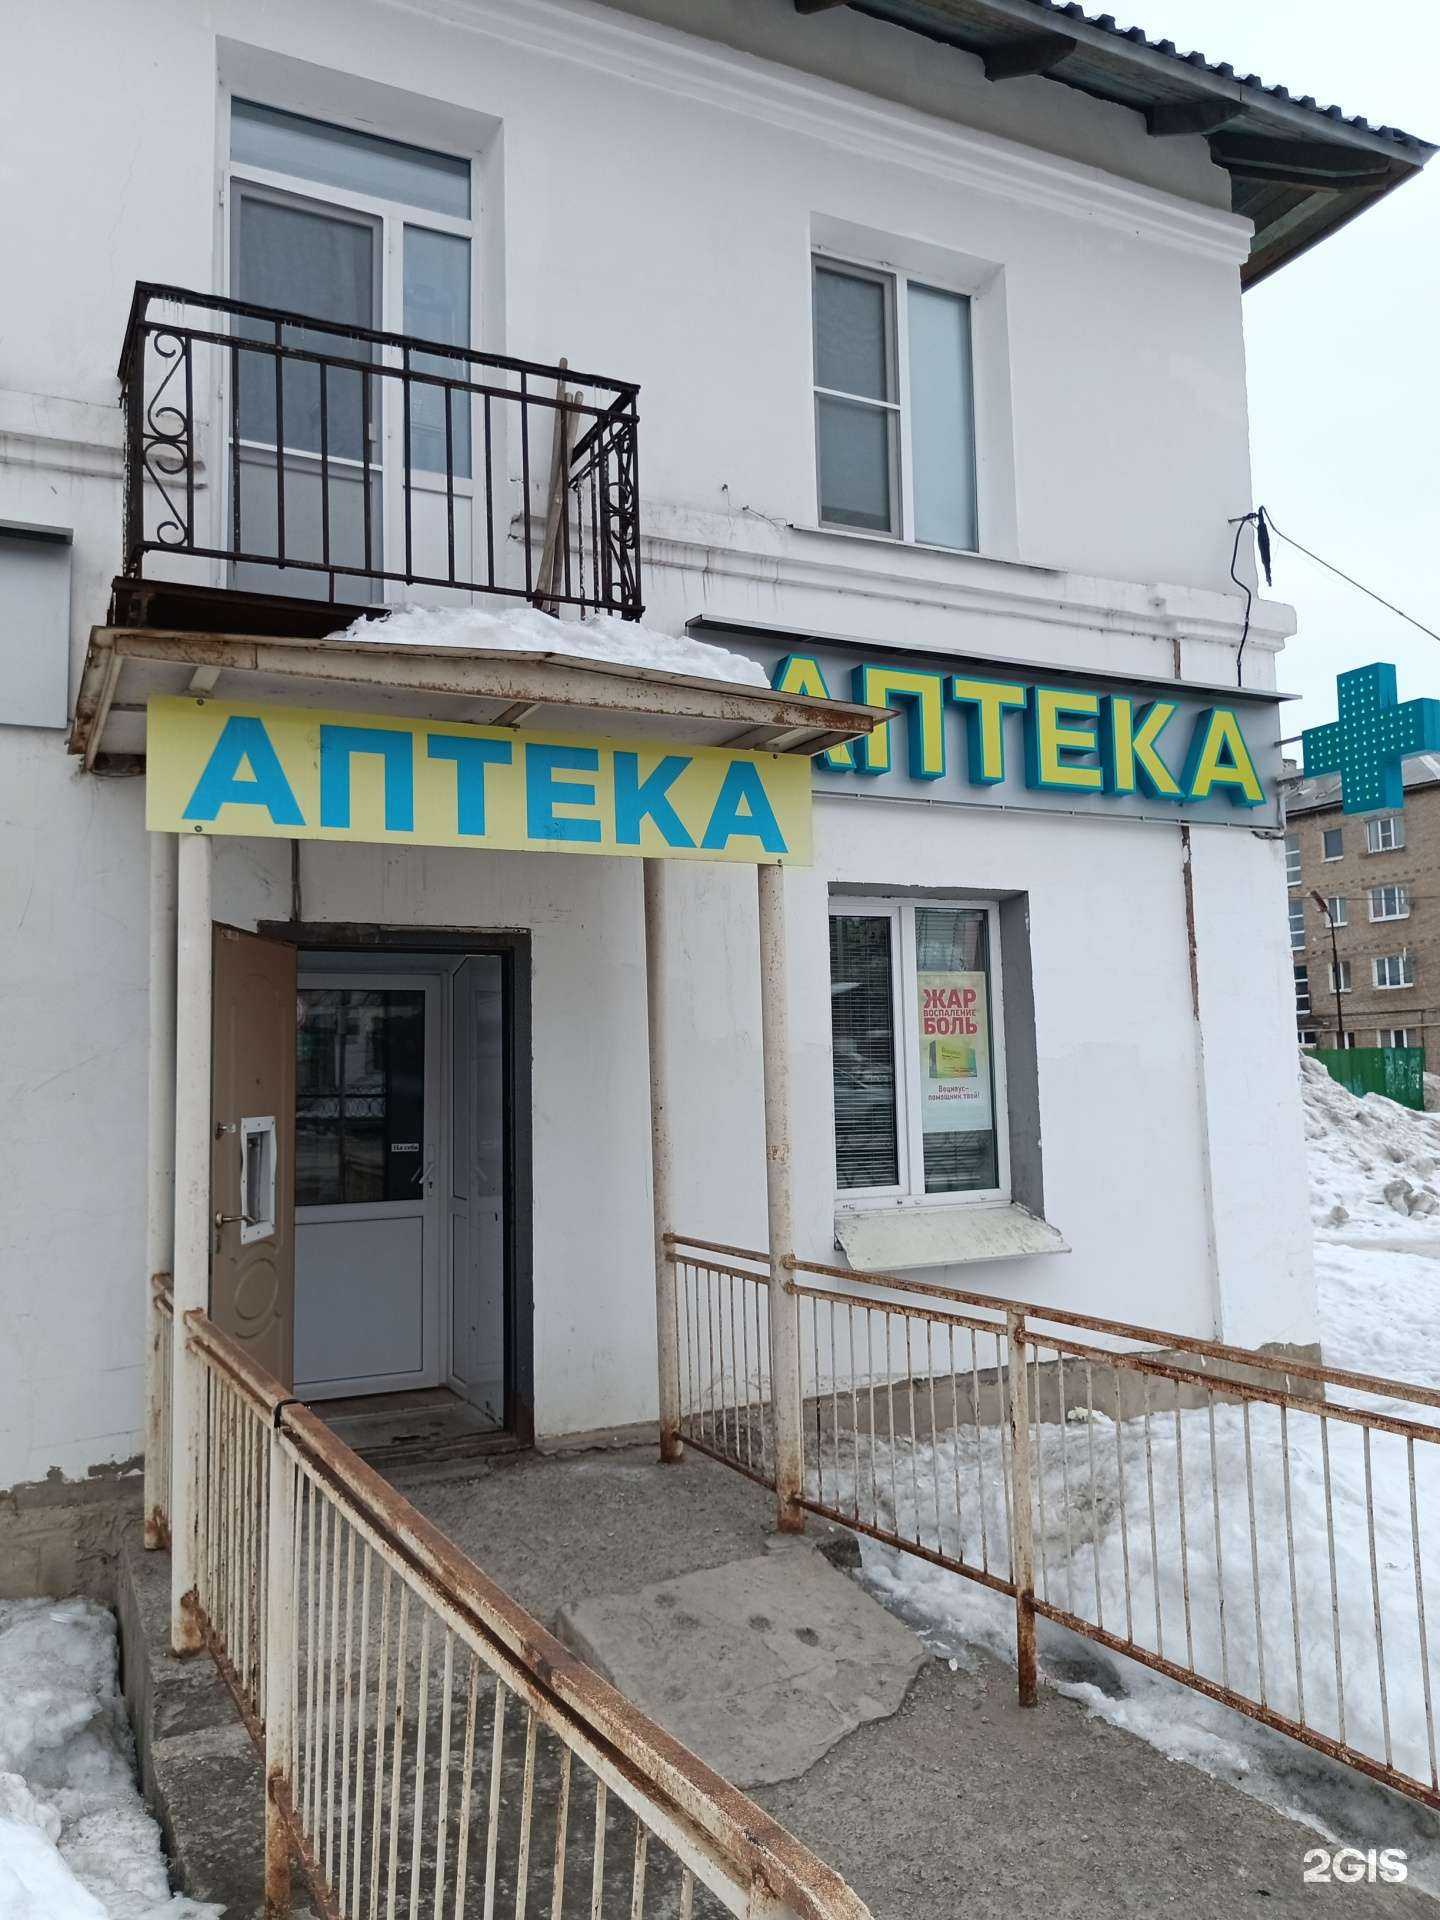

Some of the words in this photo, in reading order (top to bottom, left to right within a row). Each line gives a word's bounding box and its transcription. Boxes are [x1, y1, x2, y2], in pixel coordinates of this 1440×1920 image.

[181, 715, 789, 853] АПТЕКА
[923, 989, 976, 1008] ЖАР
[923, 1009, 976, 1017] ВОСПАЛЕНИЕ
[924, 1017, 977, 1034] БОЛЬ
